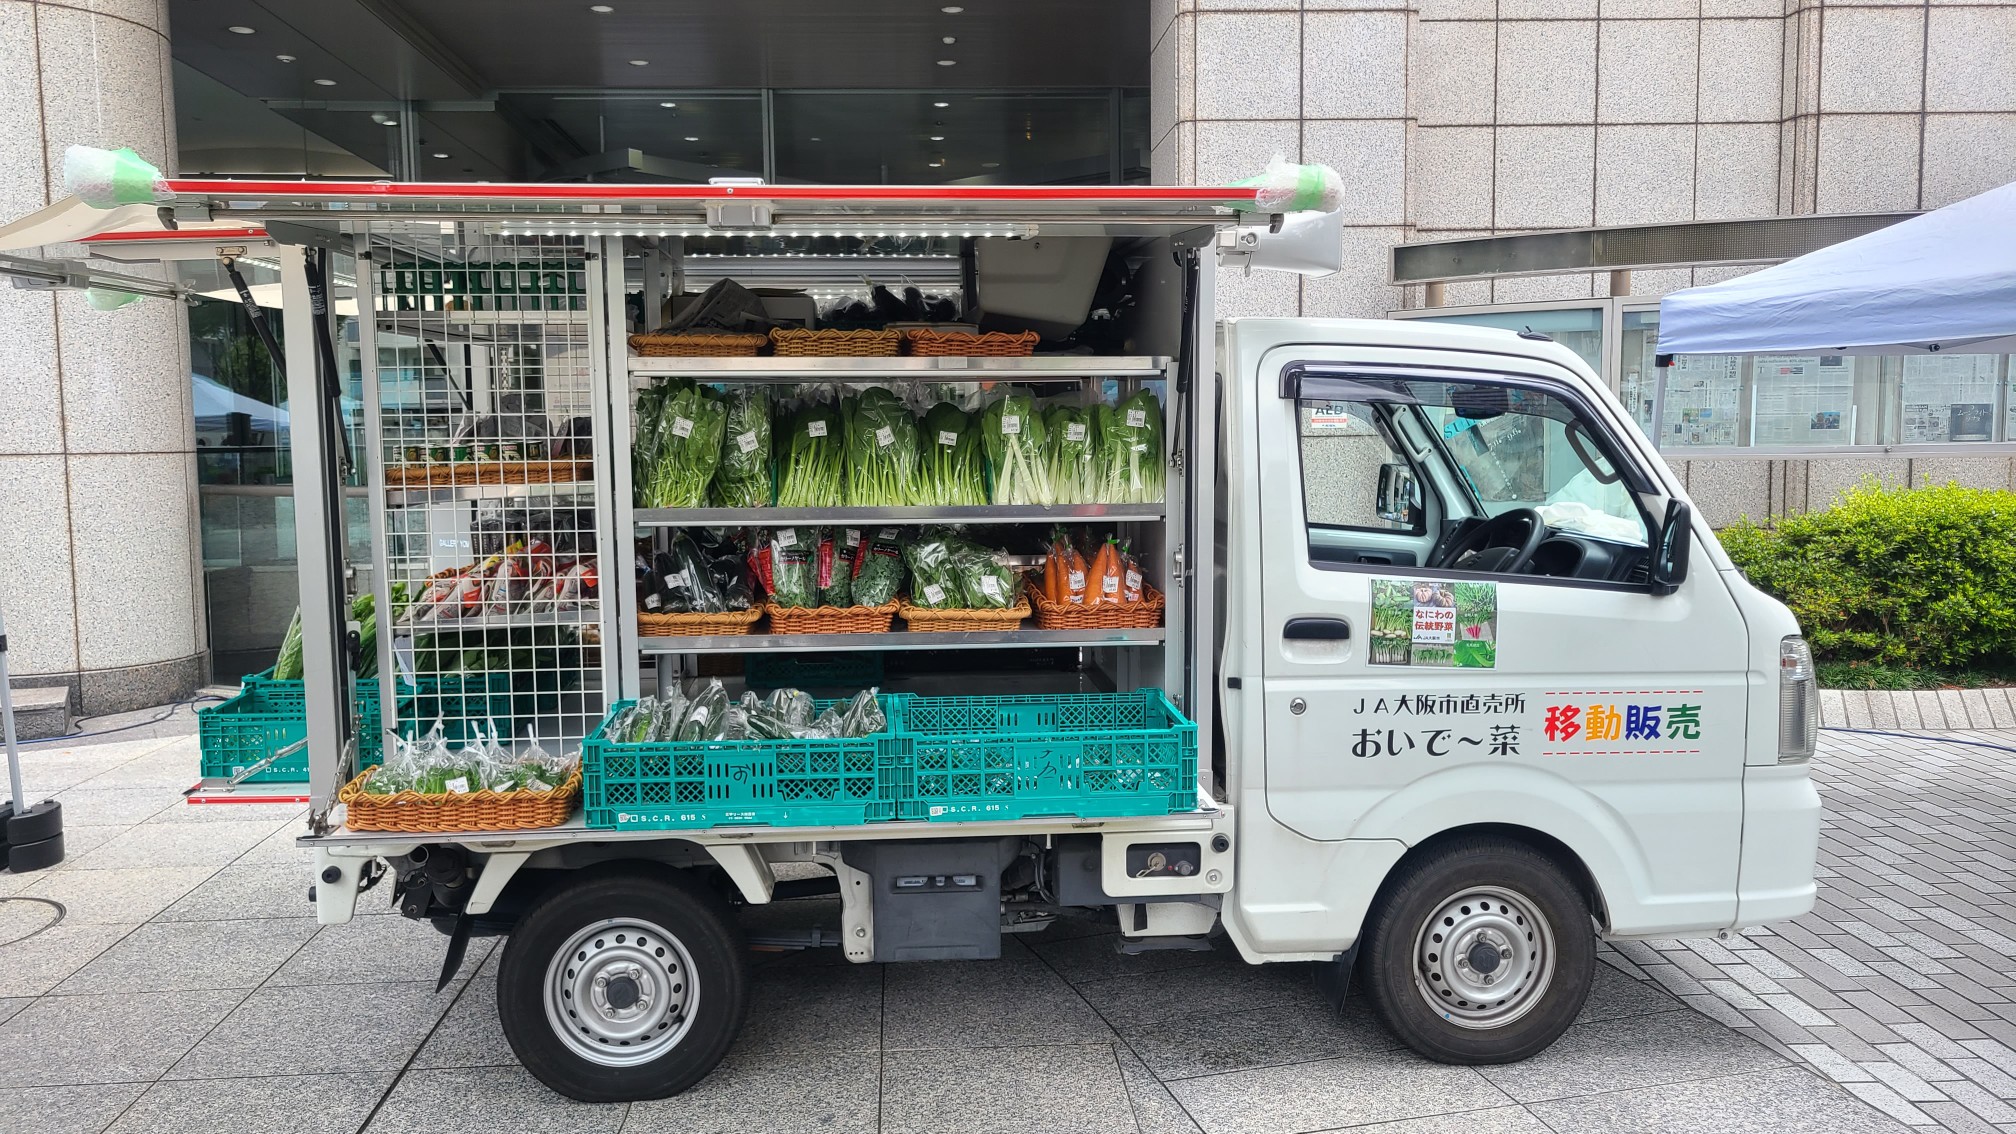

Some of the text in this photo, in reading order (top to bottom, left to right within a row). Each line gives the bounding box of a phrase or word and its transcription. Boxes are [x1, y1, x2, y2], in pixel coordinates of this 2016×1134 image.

[1315, 405, 1344, 415] AED
[1415, 609, 1454, 620] なにわの
[1414, 620, 1454, 632] 伝統野菜
[1544, 703, 1702, 743] 移動販売
